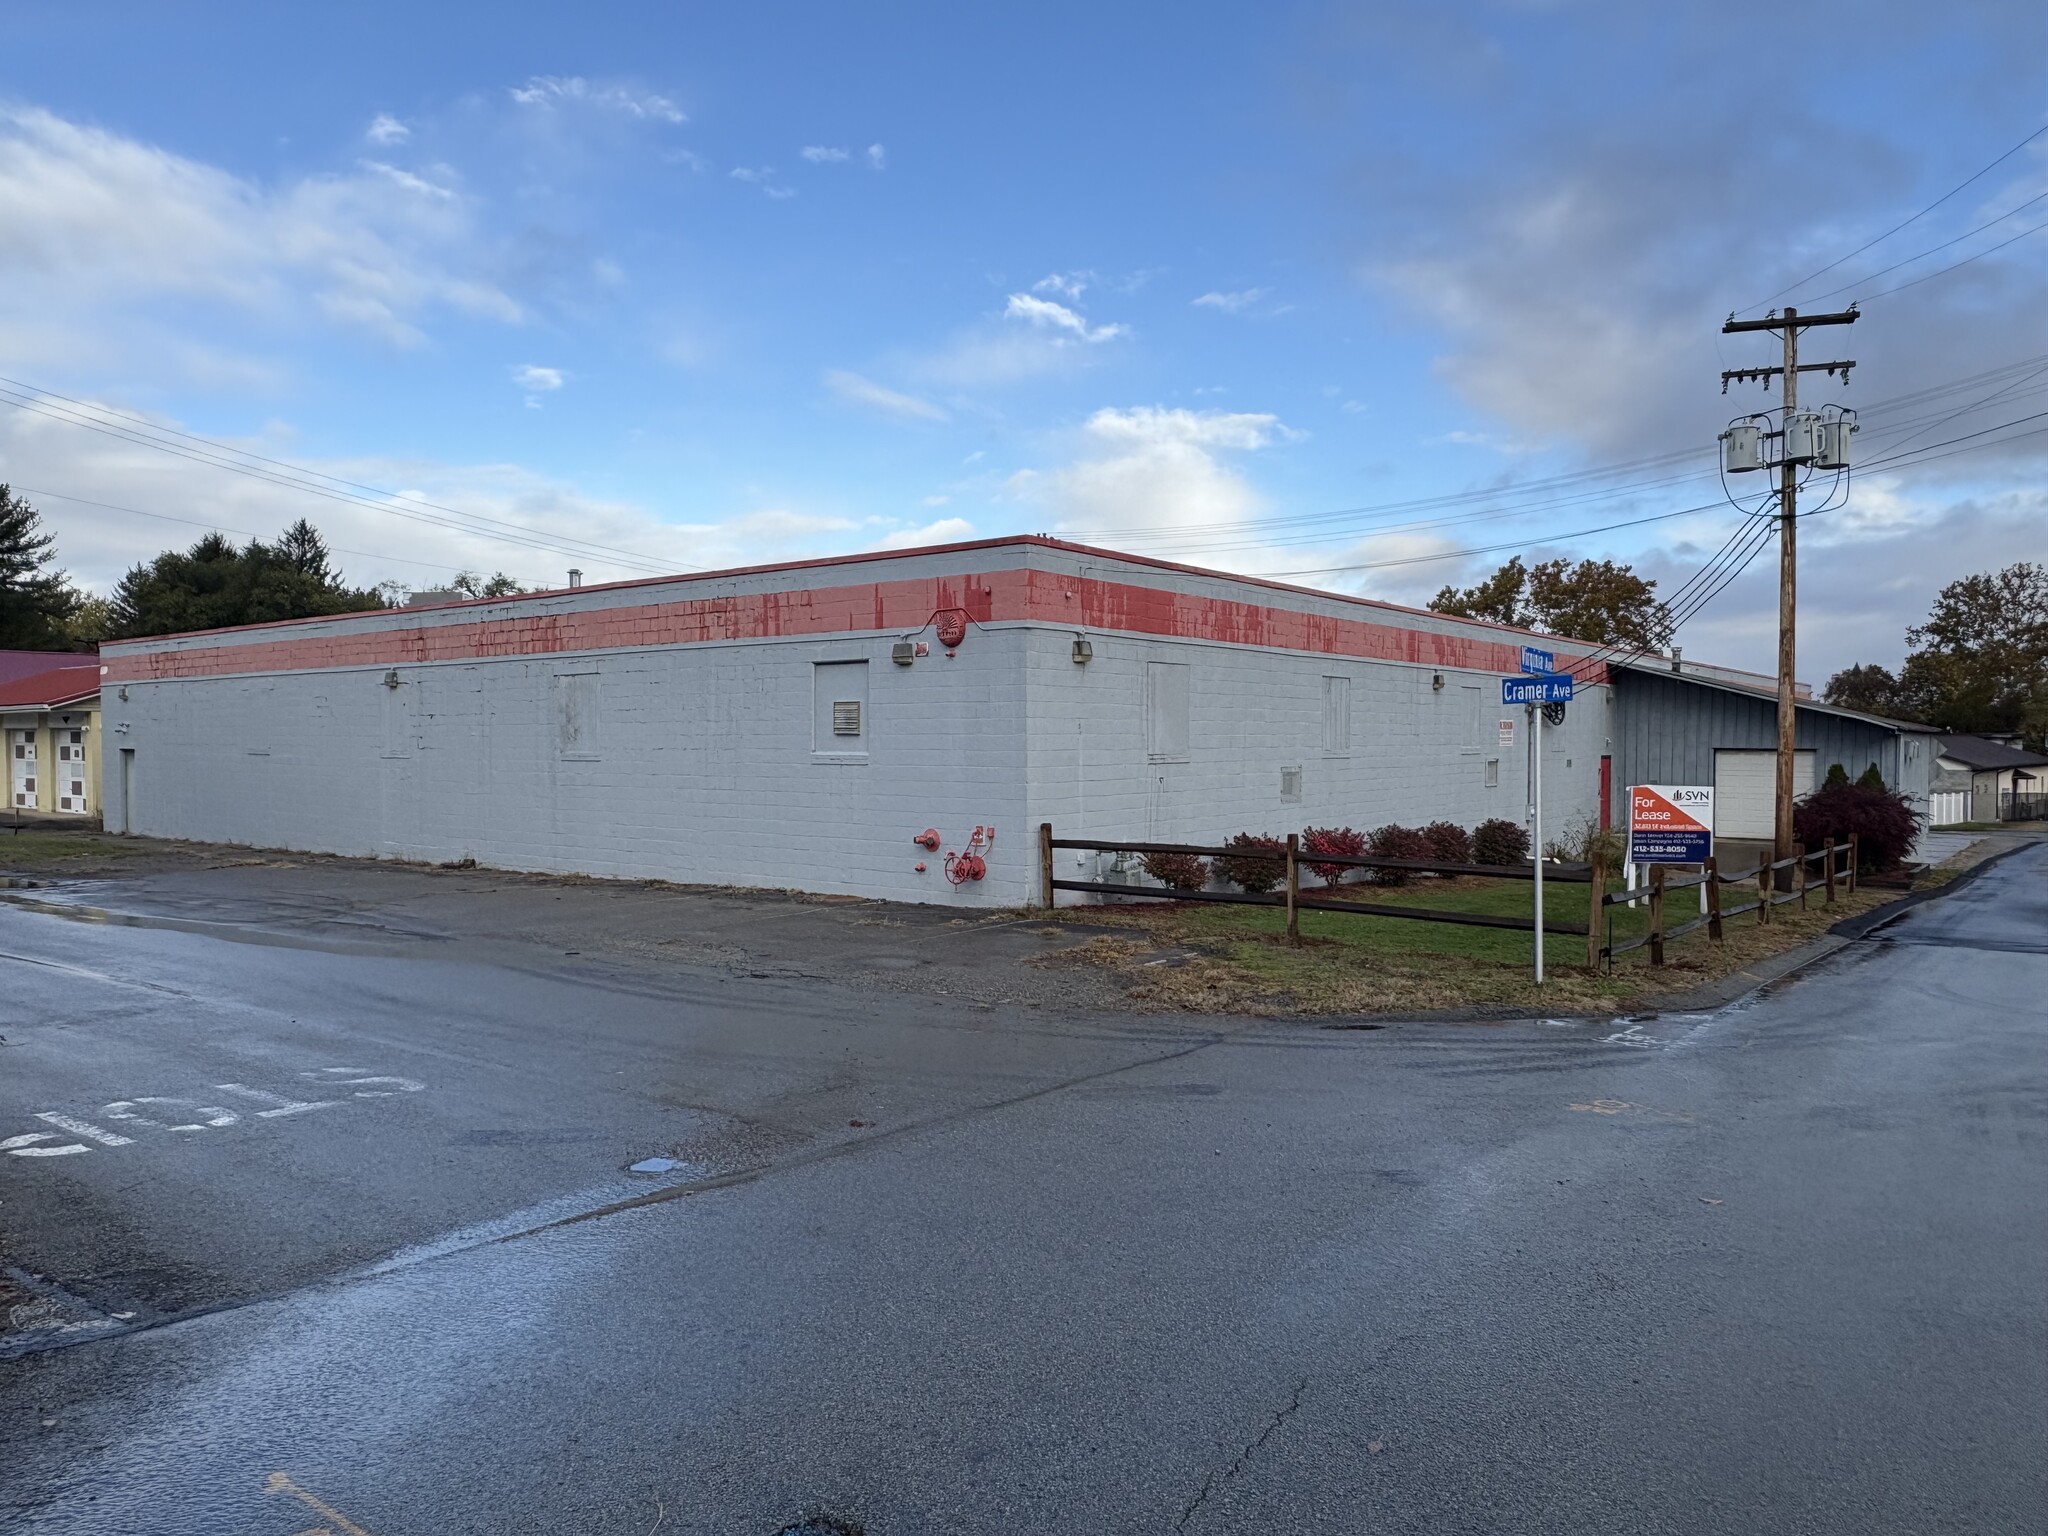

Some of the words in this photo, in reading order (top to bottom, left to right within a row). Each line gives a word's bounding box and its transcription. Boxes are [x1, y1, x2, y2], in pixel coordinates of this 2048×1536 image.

[1522, 646, 1543, 673] Virginia
[1544, 657, 1553, 672] Ave
[1504, 682, 1548, 701] Cramer
[1553, 684, 1571, 698] Ave
[1685, 791, 1709, 800] SVN
[1635, 797, 1655, 808] For
[1635, 809, 1670, 820] Lease
